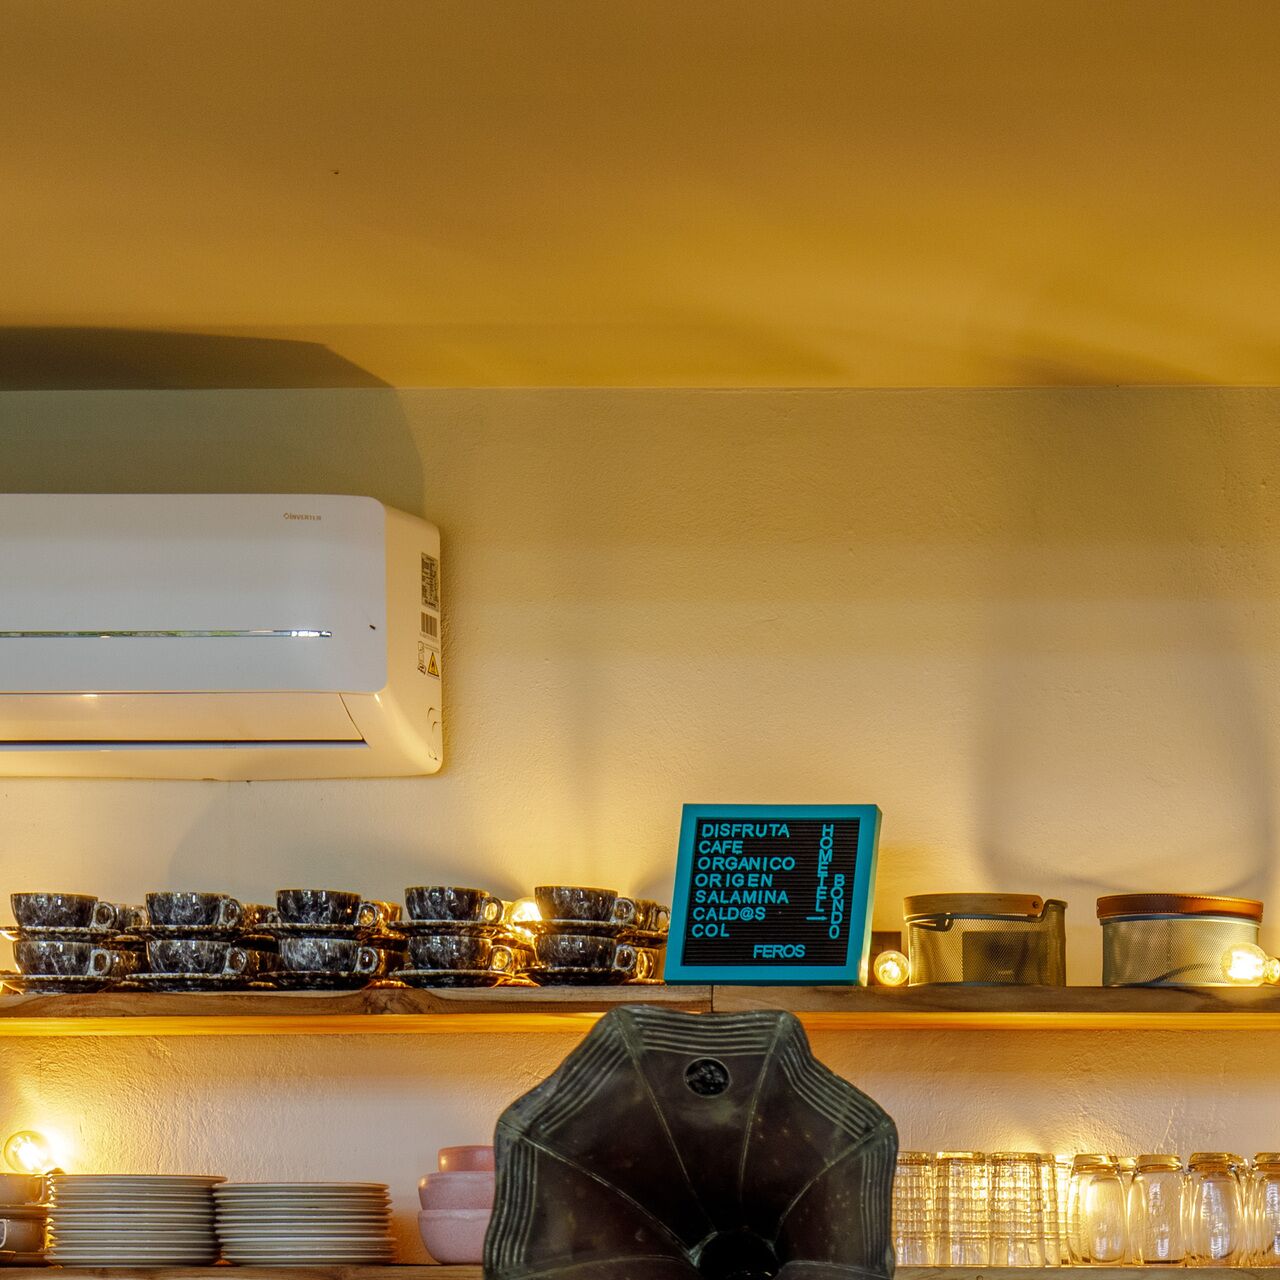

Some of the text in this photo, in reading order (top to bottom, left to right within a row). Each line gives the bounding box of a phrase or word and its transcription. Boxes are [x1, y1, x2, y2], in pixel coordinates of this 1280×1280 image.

[701, 823, 790, 838] DISFRUTA
[698, 840, 743, 854] CAFE
[697, 856, 796, 871] ORGANICO
[694, 873, 773, 888] ORIGEN
[694, 890, 789, 904] SALAMINA
[692, 907, 766, 921] CALD@S
[691, 923, 730, 938] COL
[753, 944, 805, 959] FEROS
